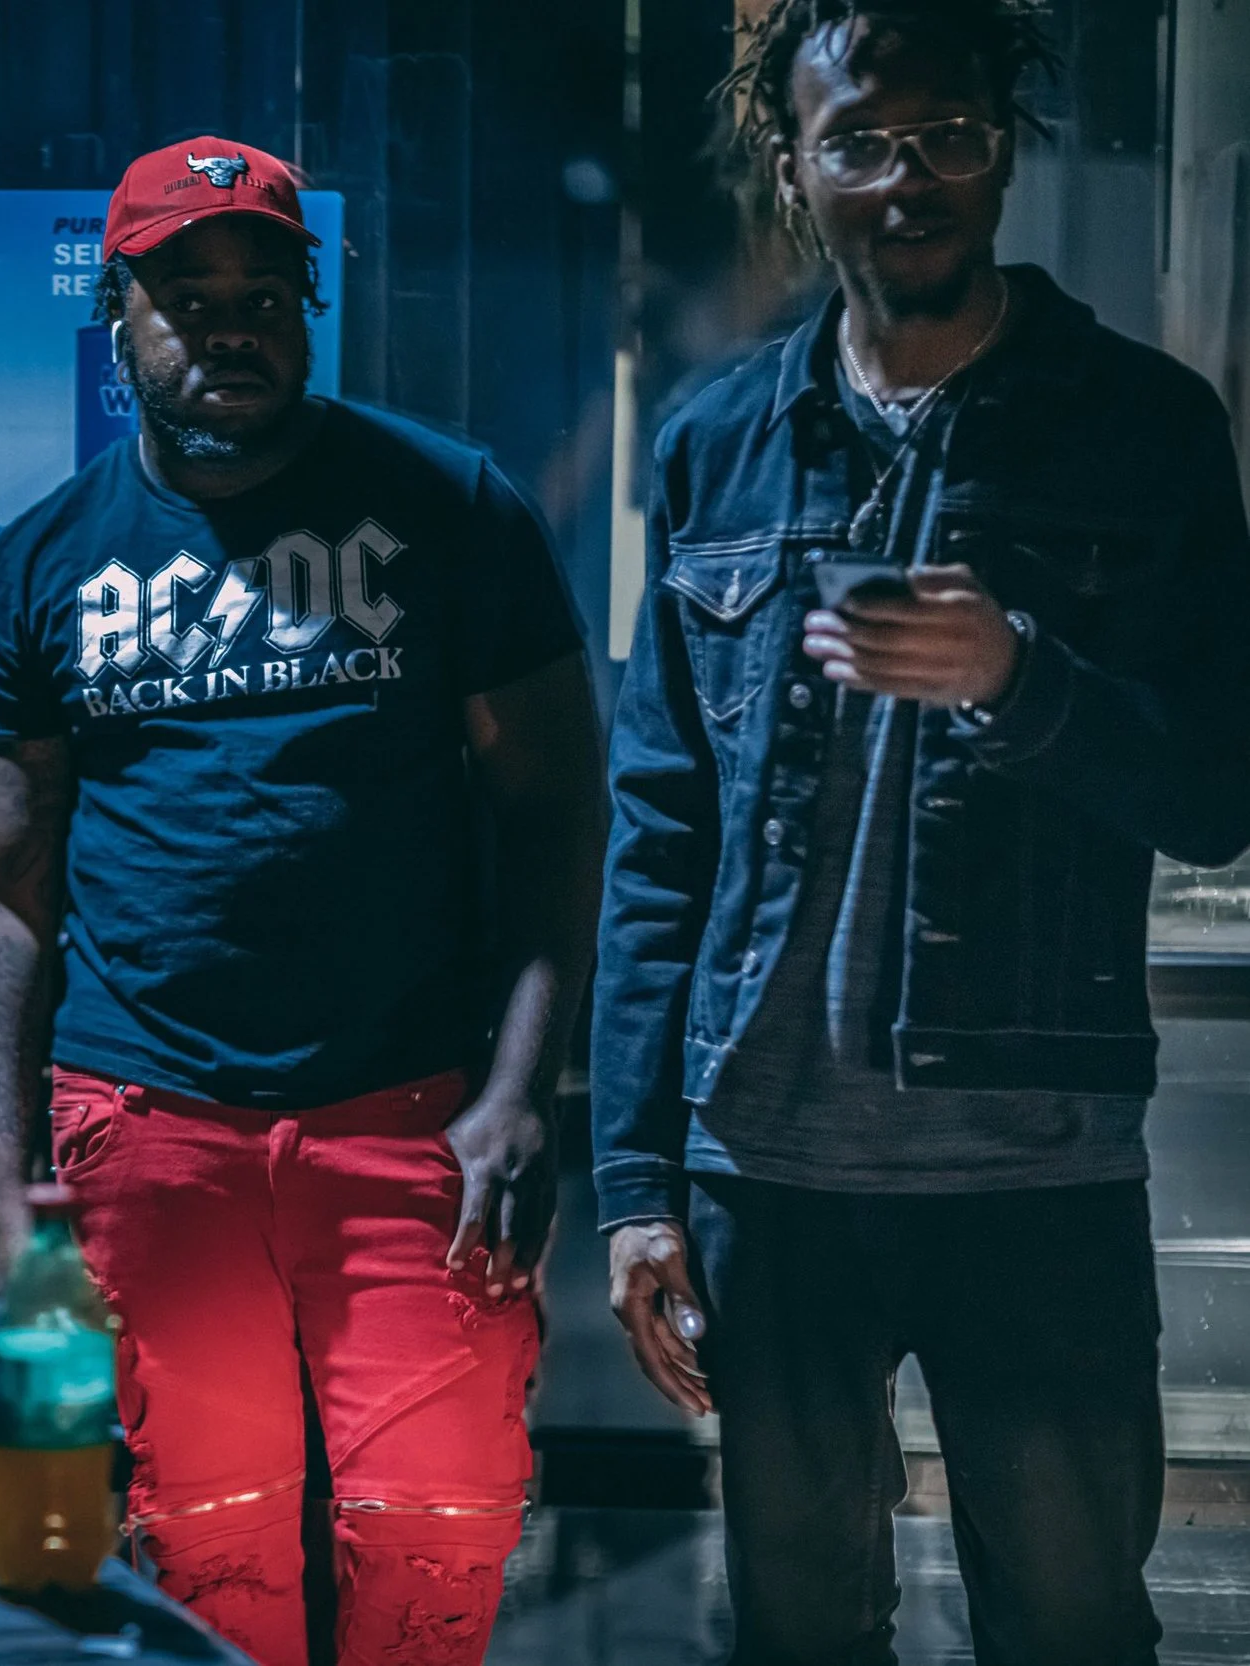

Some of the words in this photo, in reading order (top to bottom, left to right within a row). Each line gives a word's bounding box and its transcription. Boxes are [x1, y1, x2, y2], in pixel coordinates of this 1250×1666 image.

[53, 217, 104, 235] PUR
[52, 274, 99, 296] RE
[81, 674, 197, 718] BACK
[204, 665, 250, 701] IN
[260, 647, 405, 693] BLACK
